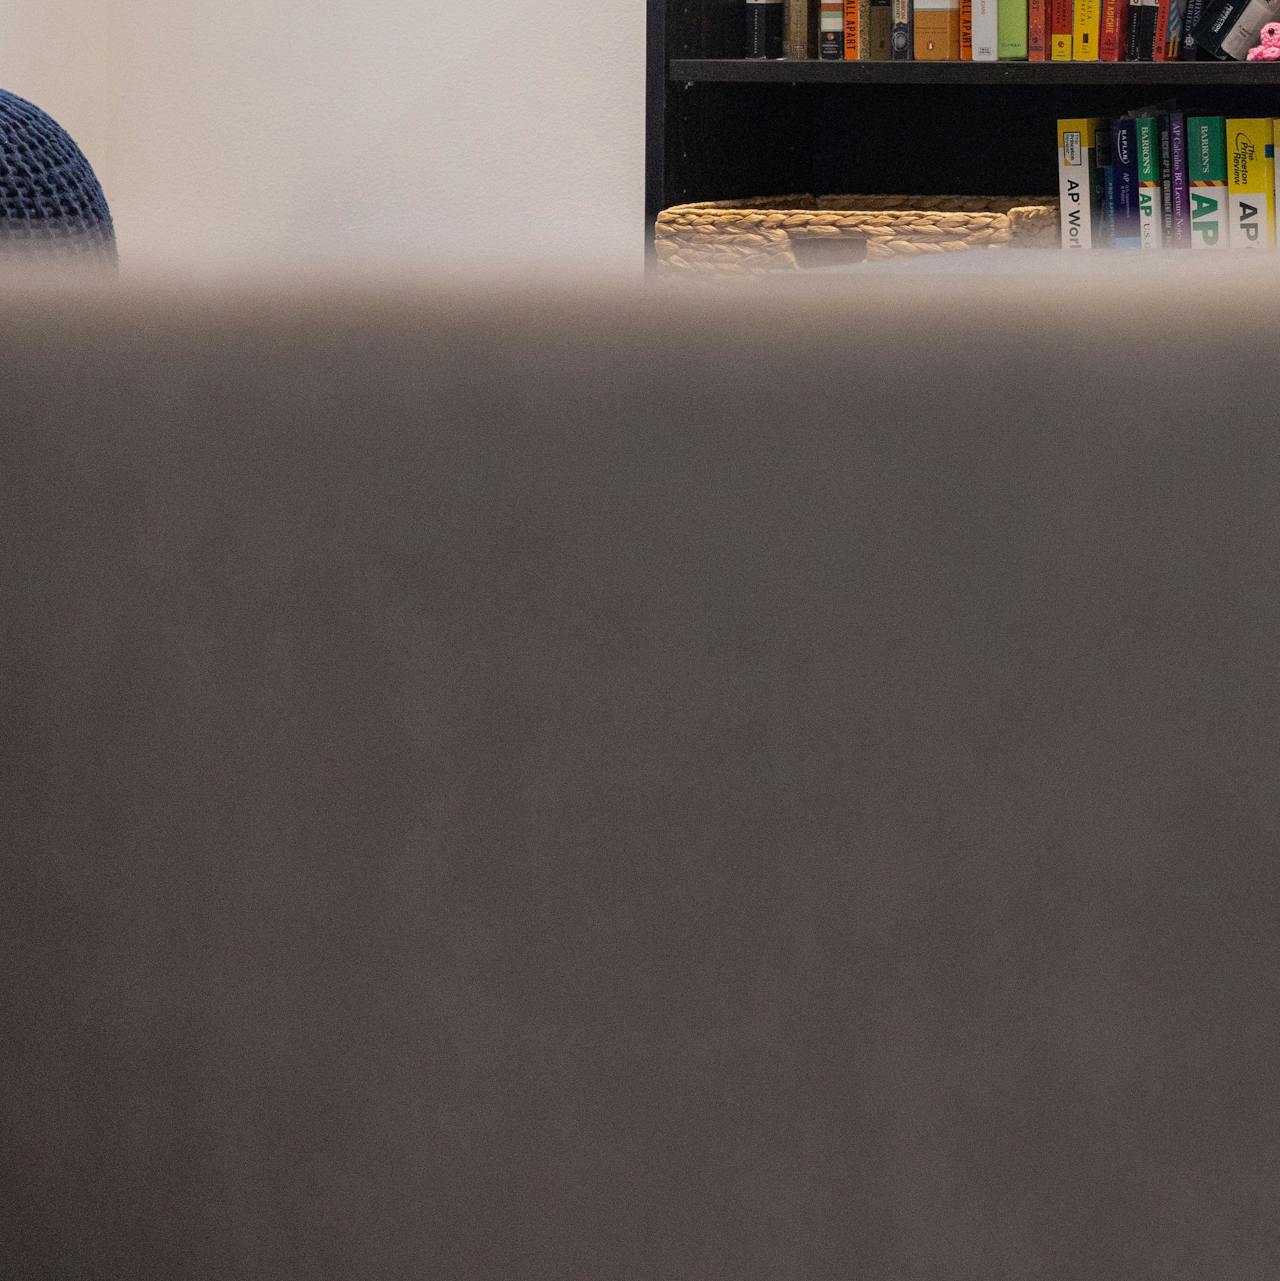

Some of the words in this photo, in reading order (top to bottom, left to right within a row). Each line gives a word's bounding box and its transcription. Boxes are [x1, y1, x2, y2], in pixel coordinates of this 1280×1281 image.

[1105, 6, 1116, 34] ADICHIE
[1214, 4, 1234, 34] PERFECTION
[846, 20, 857, 51] APART
[962, 20, 972, 50] APART
[1172, 122, 1182, 136] AP
[1141, 126, 1150, 175] BARRON'S
[1172, 136, 1182, 171] Calculus
[1200, 125, 1210, 174] BARRON'S
[1122, 172, 1130, 184] AP
[1174, 172, 1183, 186] BC
[1232, 152, 1241, 186] Review
[1067, 178, 1080, 203] AP
[1139, 193, 1152, 217] AP
[1163, 180, 1172, 214] GOVERNMENT
[1174, 186, 1183, 216] Lecture
[1068, 209, 1082, 249] Worl
[1192, 192, 1219, 246] AP
[1240, 201, 1258, 242] AP
